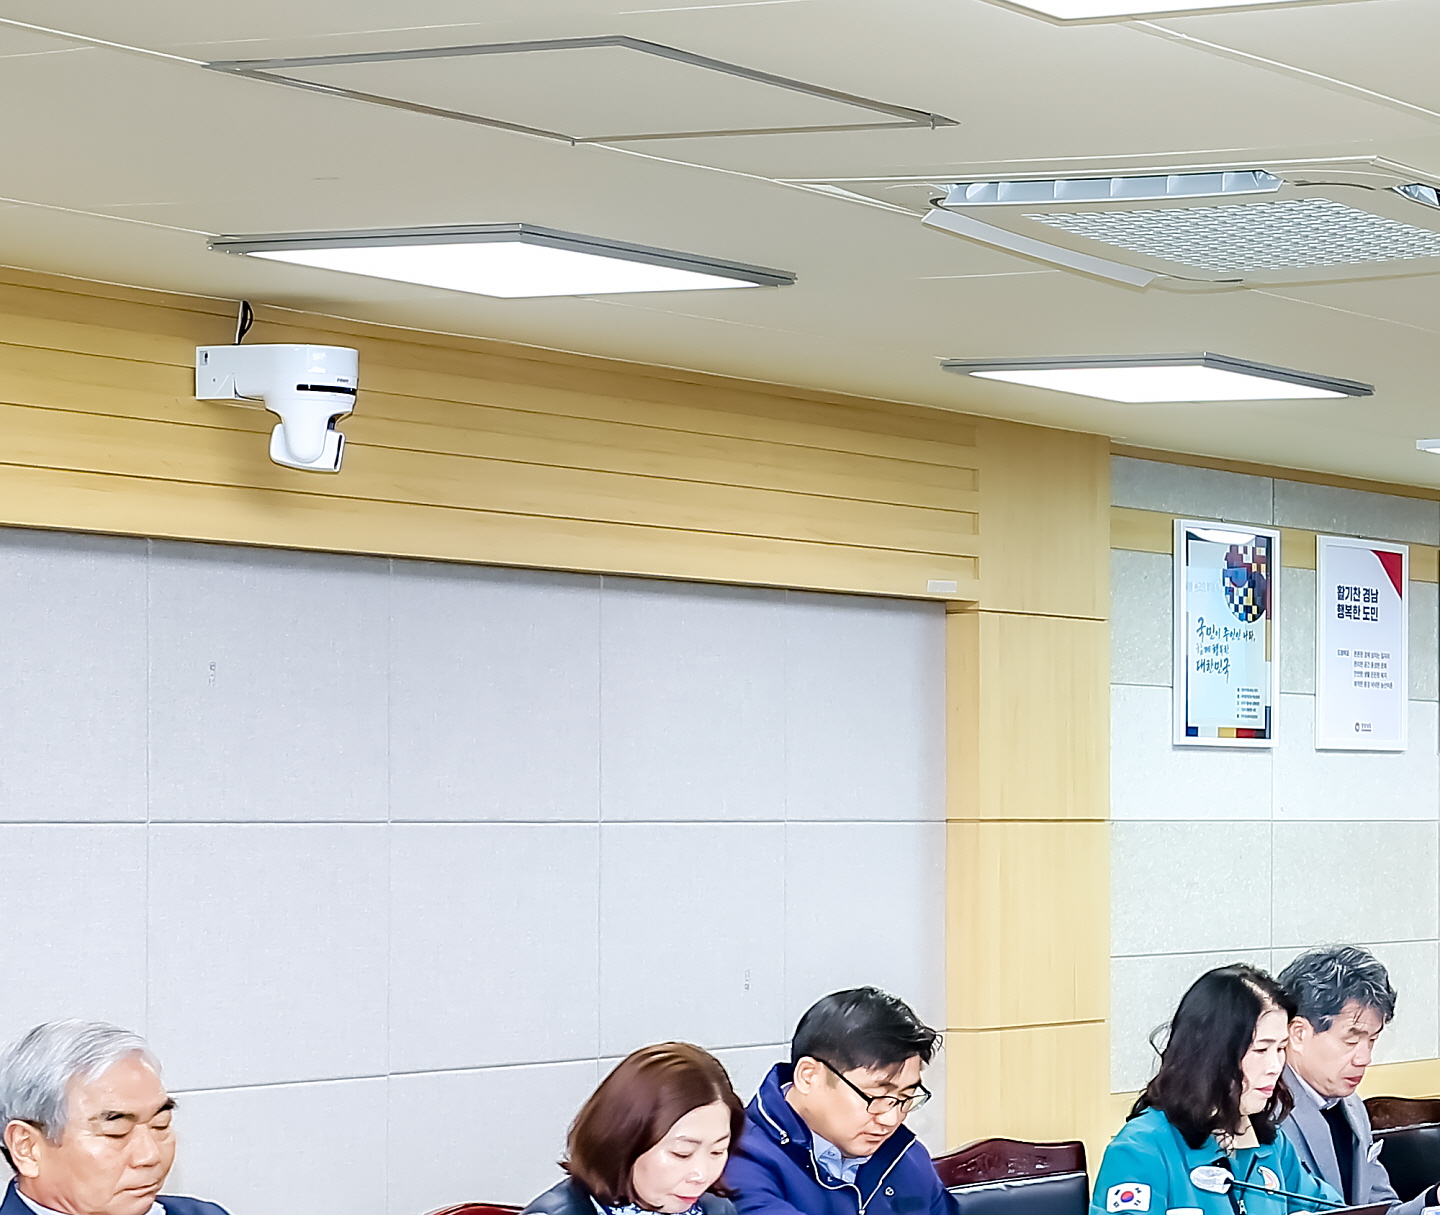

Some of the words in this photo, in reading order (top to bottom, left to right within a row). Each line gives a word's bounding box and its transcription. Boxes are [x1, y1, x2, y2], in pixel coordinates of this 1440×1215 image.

[1337, 585, 1361, 602] 활기찬
[1362, 587, 1379, 604] 경남
[1337, 603, 1361, 620] 행복한
[1362, 606, 1379, 622] 도민
[1196, 616, 1221, 643] 국민이
[1196, 657, 1231, 685] 대한민국
